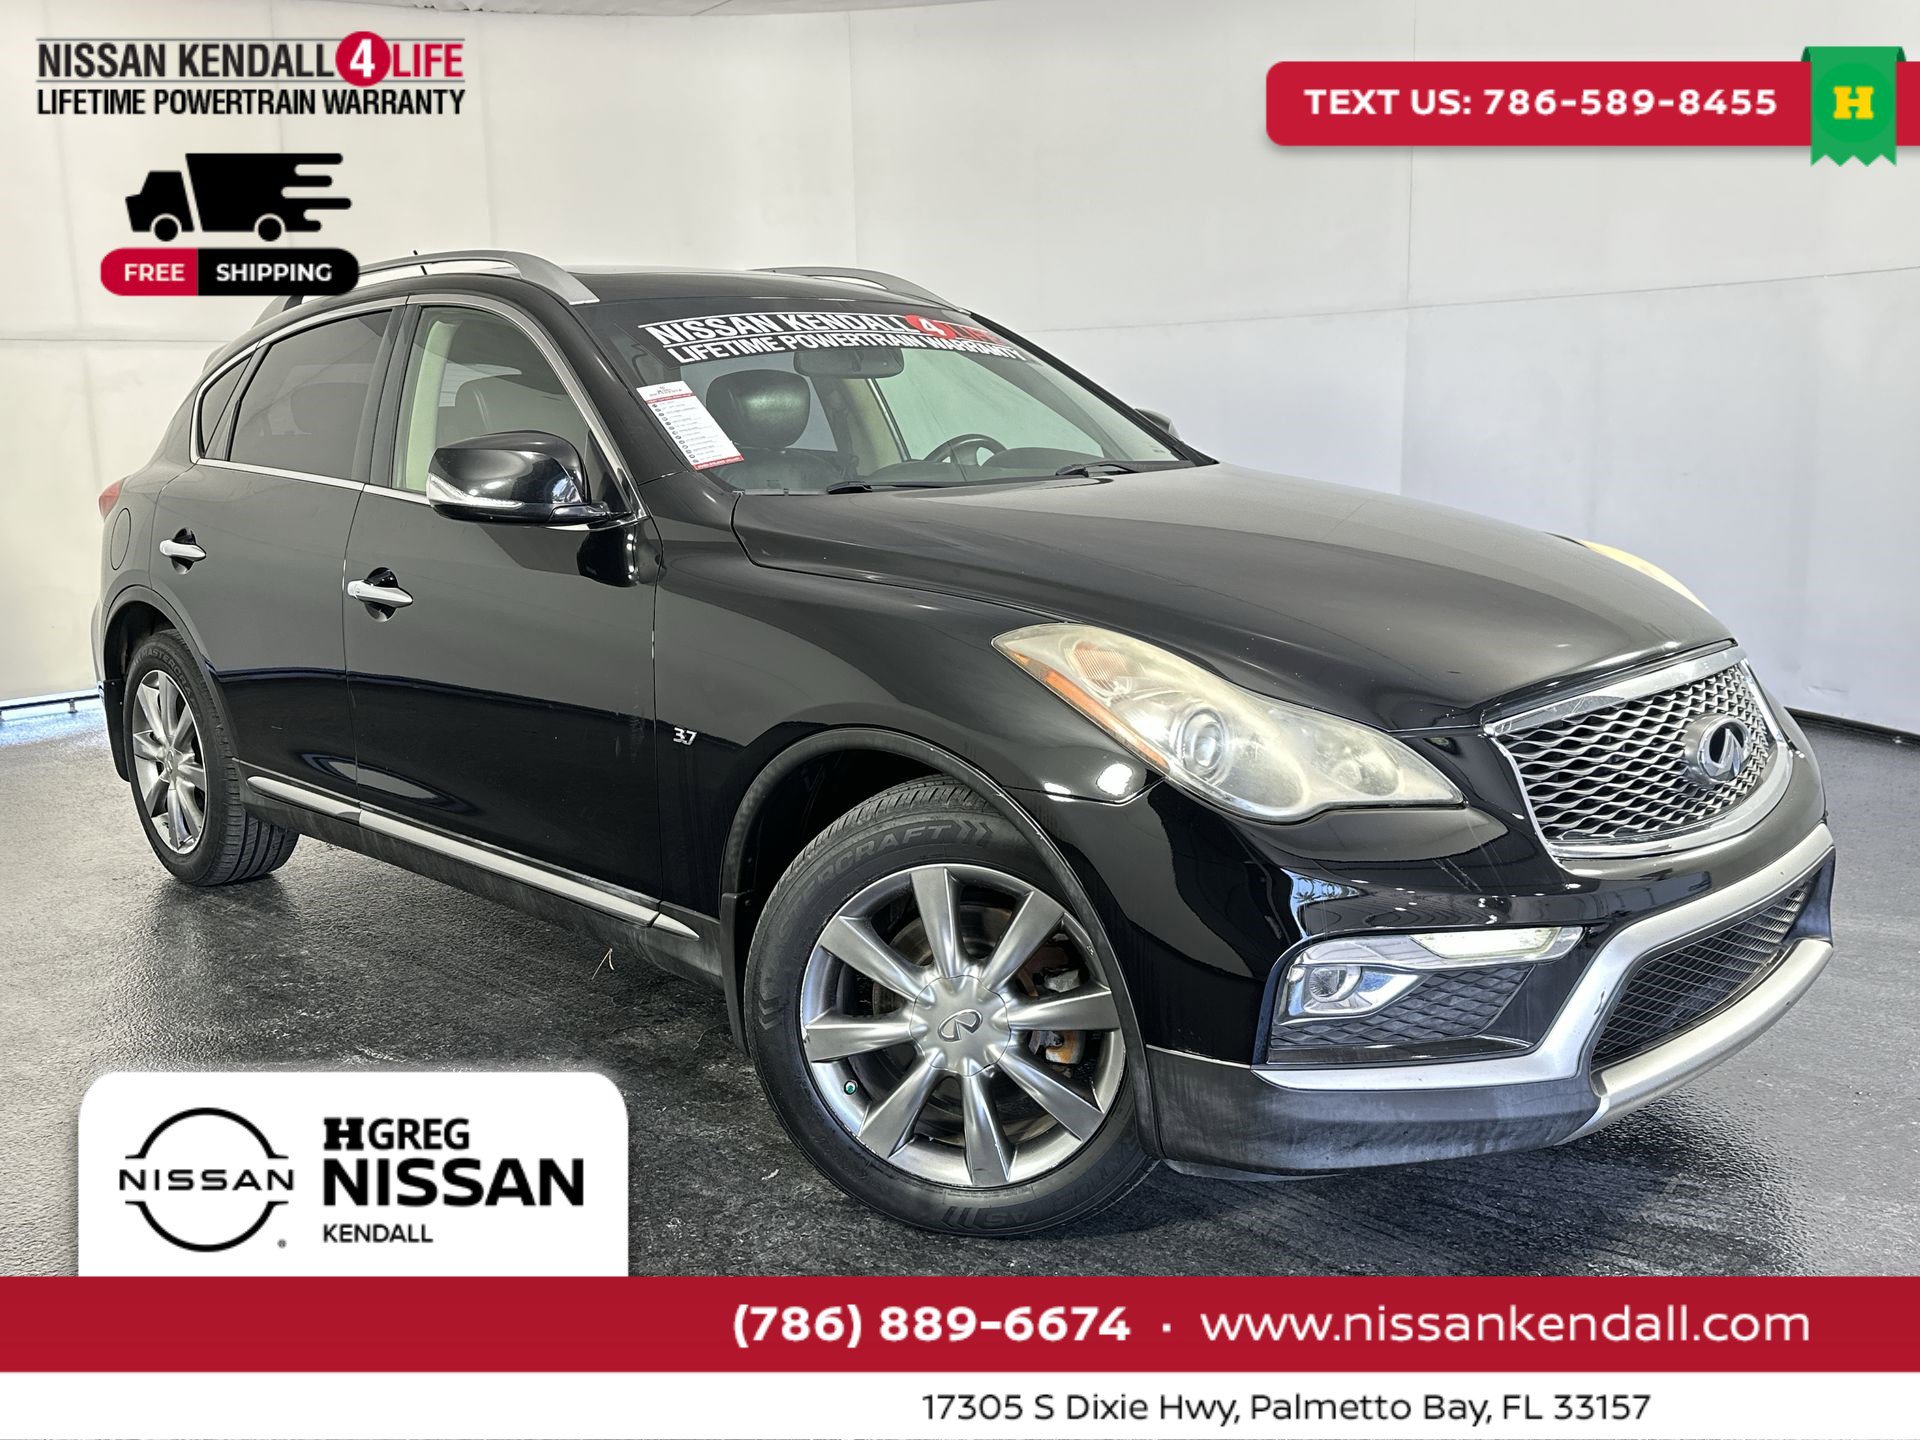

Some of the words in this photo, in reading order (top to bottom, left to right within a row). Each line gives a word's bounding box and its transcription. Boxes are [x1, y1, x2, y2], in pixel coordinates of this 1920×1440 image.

[645, 314, 784, 345] NISSAN
[777, 314, 920, 333] KENDALL
[917, 317, 946, 337] 4
[667, 335, 785, 364] LIFETIME
[777, 333, 928, 351] POWERTRAIN
[924, 336, 1027, 361] WARRANTY
